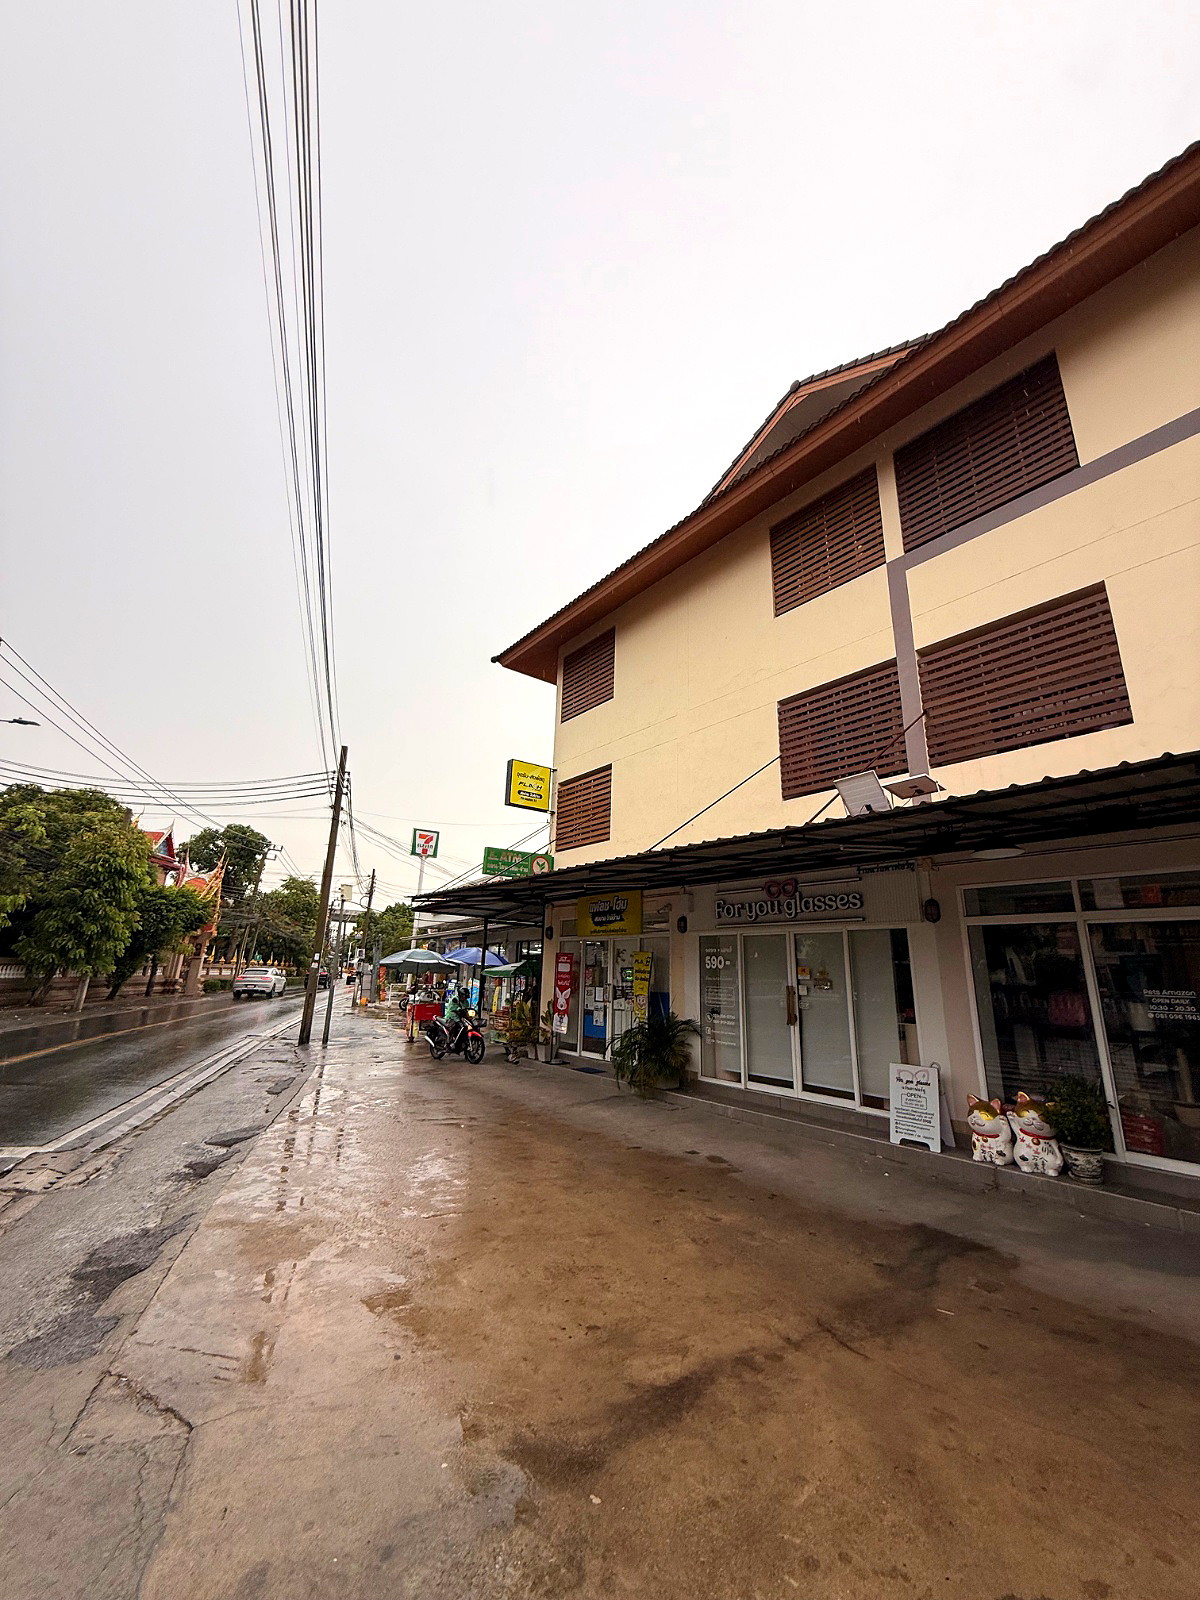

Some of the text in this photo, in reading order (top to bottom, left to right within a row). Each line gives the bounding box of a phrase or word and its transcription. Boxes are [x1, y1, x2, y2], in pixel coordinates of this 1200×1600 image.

[500, 851, 523, 863] ATM
[715, 892, 863, 921] For you glasses
